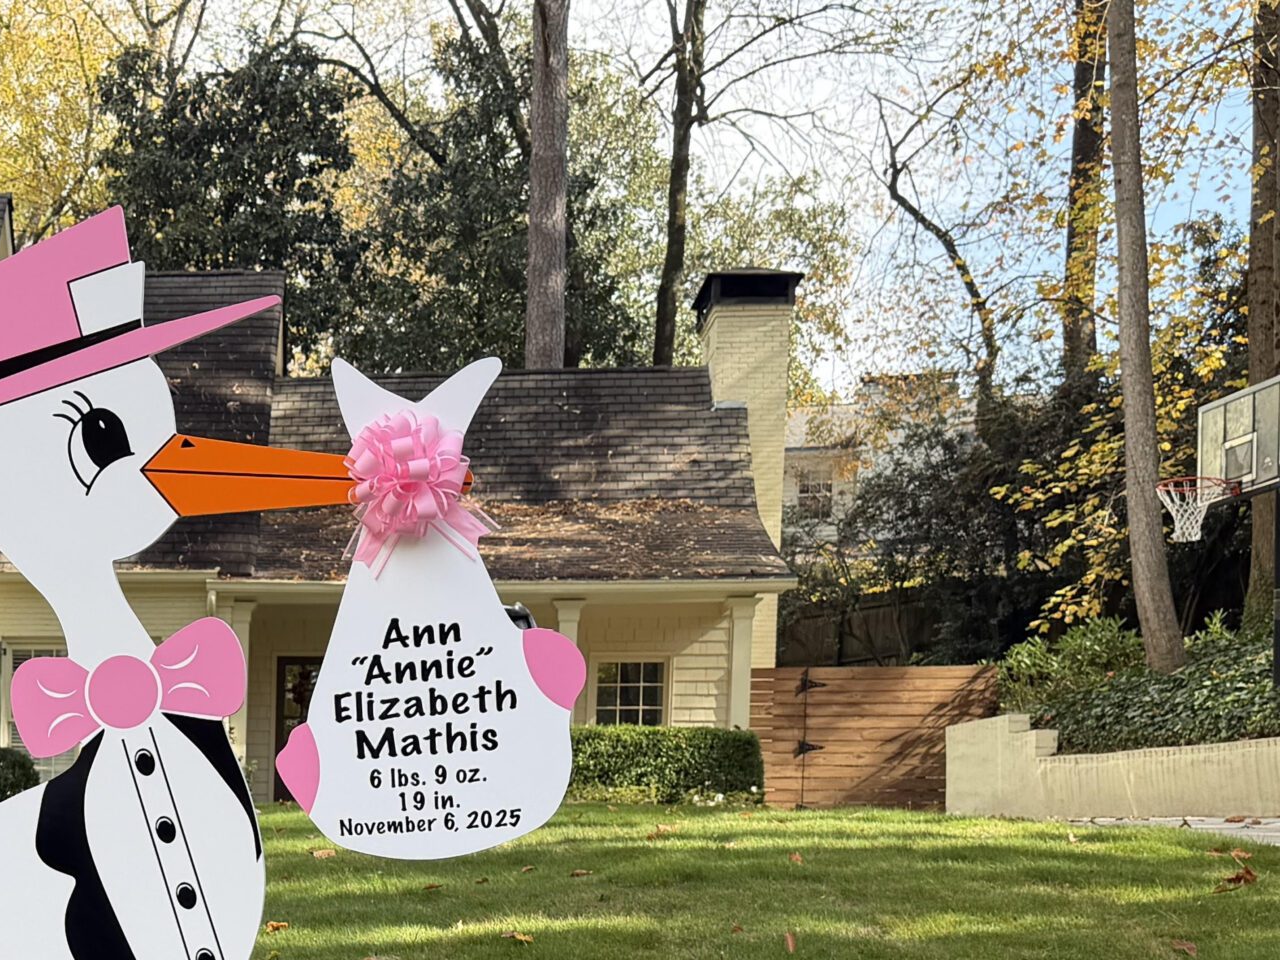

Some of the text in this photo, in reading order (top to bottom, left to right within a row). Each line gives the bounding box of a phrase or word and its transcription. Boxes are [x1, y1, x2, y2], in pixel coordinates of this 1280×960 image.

[382, 617, 462, 650] Ann
[351, 646, 494, 686] “Annie”
[334, 679, 518, 724] Elizabeth
[355, 721, 499, 760] Mathis
[369, 764, 488, 789] 6 lbs. 9 oz.
[398, 790, 461, 812] 19 in.
[339, 808, 522, 838] November 6, 2025
